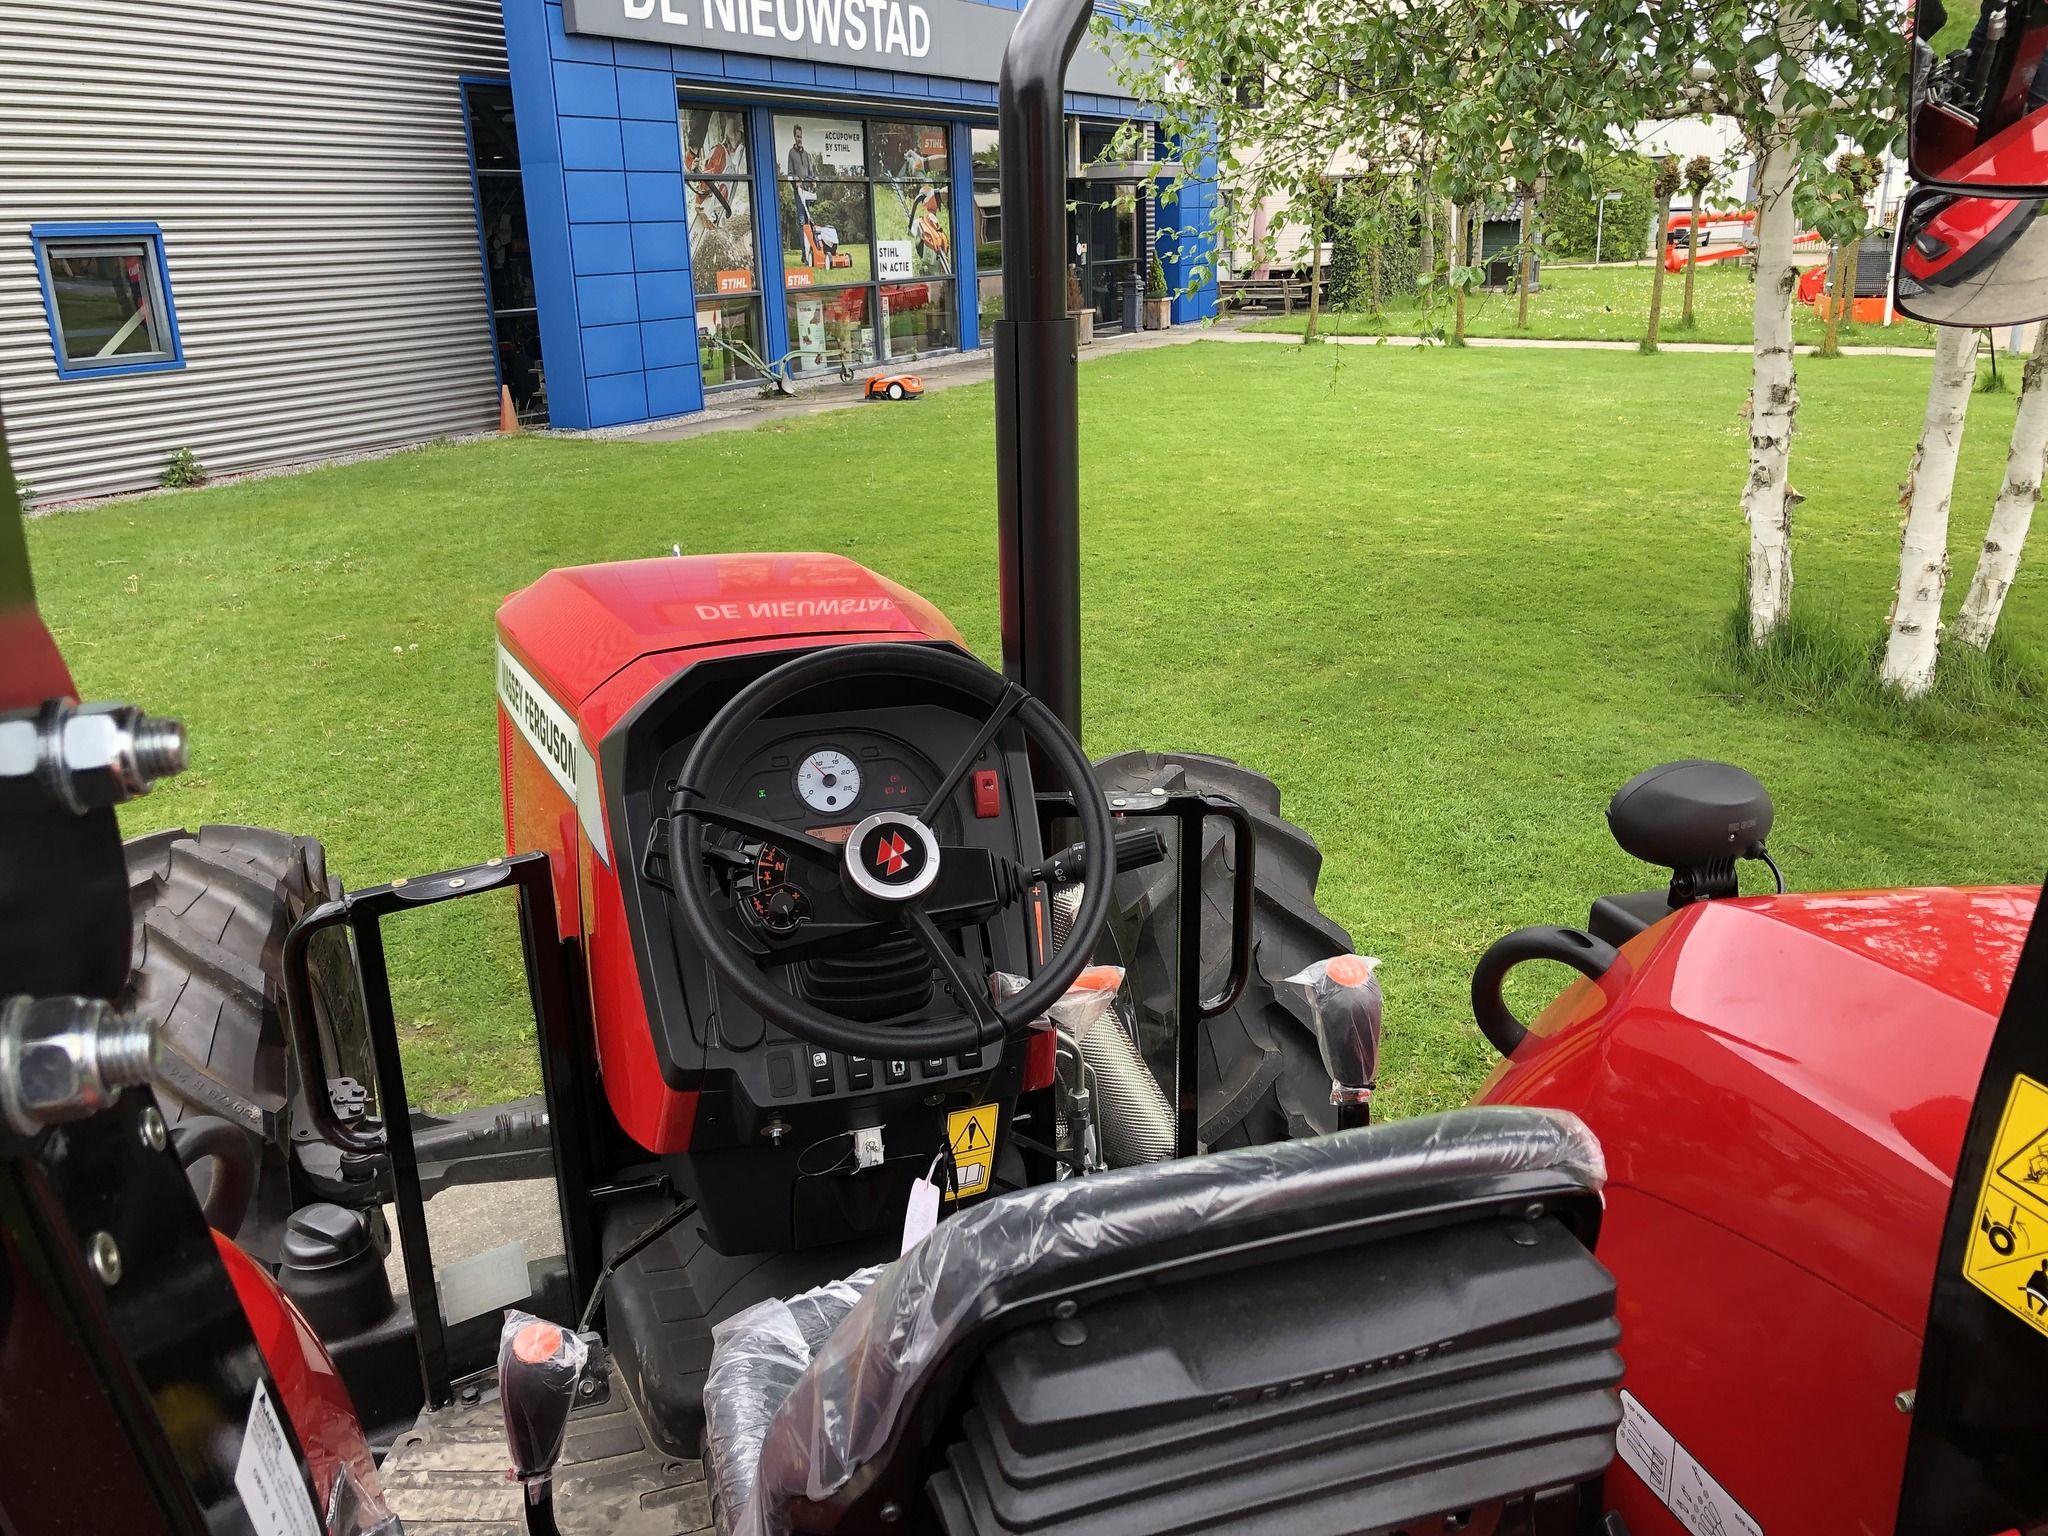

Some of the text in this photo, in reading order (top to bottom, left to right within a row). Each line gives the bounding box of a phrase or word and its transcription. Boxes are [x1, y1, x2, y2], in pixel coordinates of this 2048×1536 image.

[825, 131, 861, 141] ACCUPOWER
[825, 142, 850, 152] BY STIHL
[924, 138, 944, 149] STIHL
[879, 247, 900, 258] STIHL
[879, 262, 910, 273] IN ACTIE
[721, 277, 748, 290] STIHL
[787, 275, 811, 287] STIHL
[524, 690, 576, 785] FERGUSON
